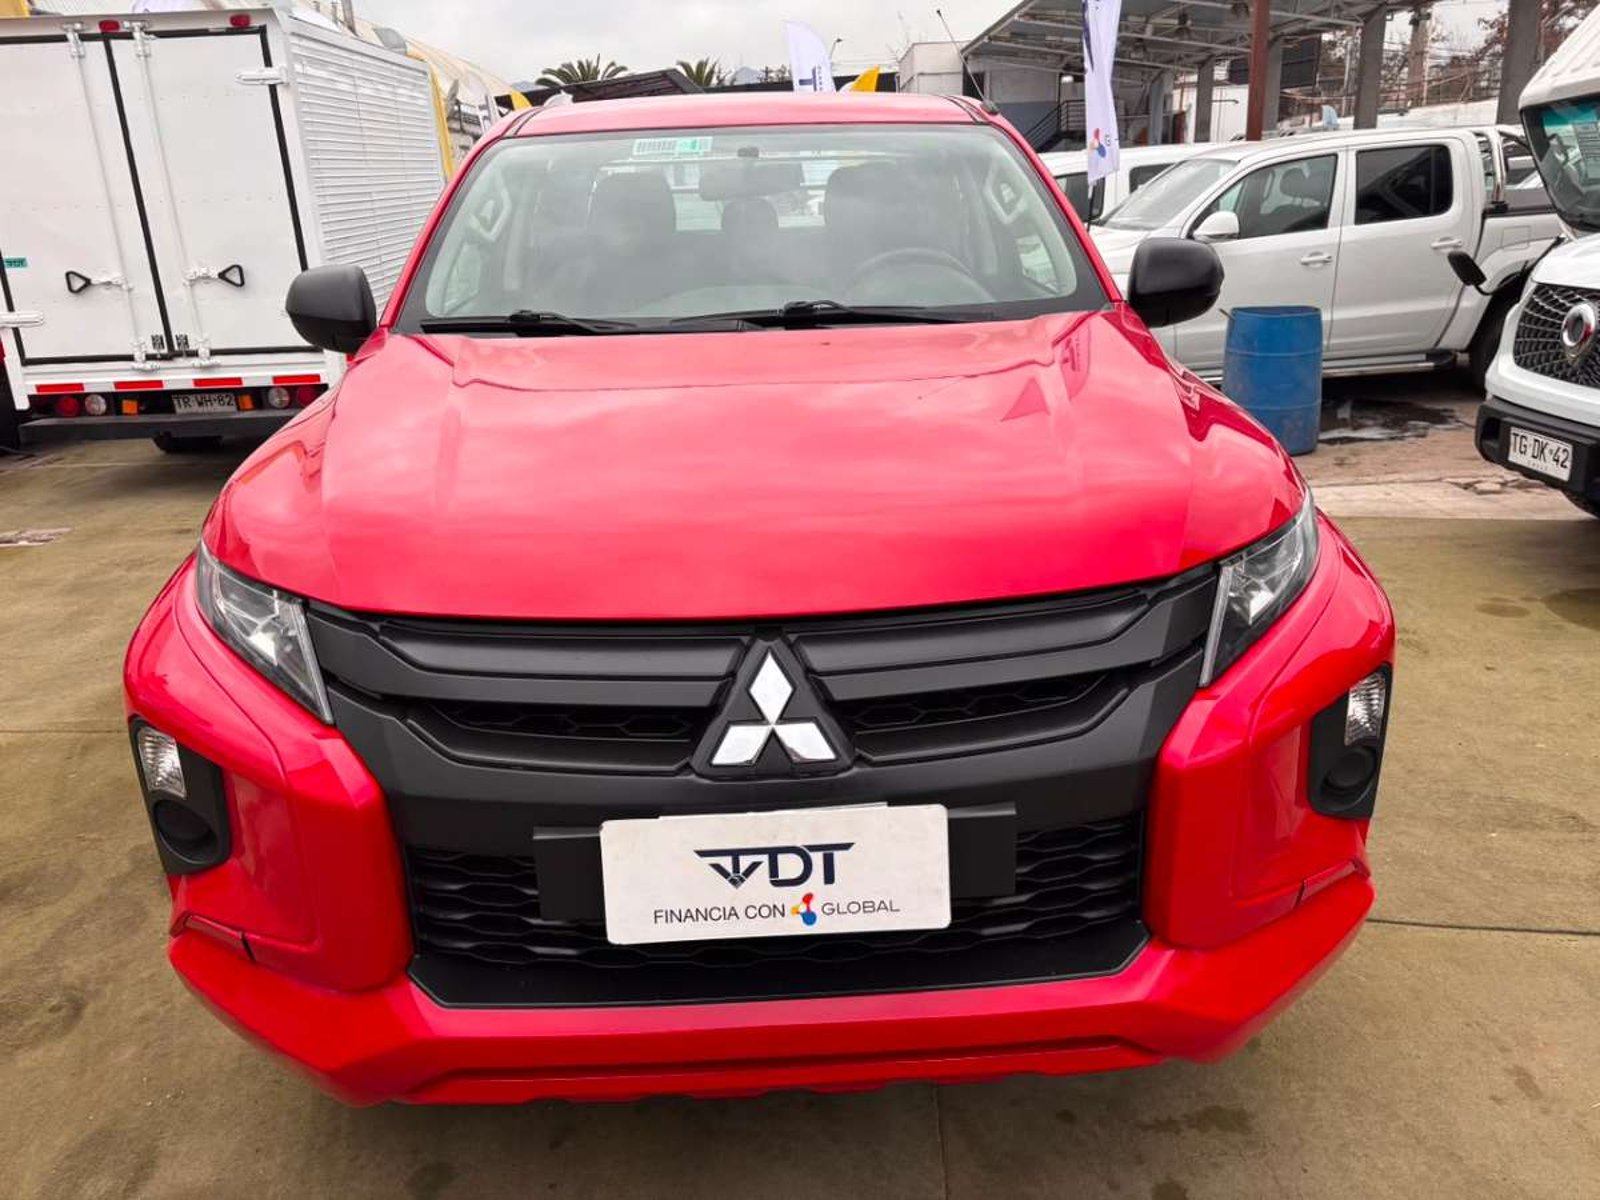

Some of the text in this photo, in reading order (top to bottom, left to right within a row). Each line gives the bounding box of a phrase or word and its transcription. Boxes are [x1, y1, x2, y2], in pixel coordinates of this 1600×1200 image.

[653, 899, 900, 925] FINANCIA CON GLOBAL
